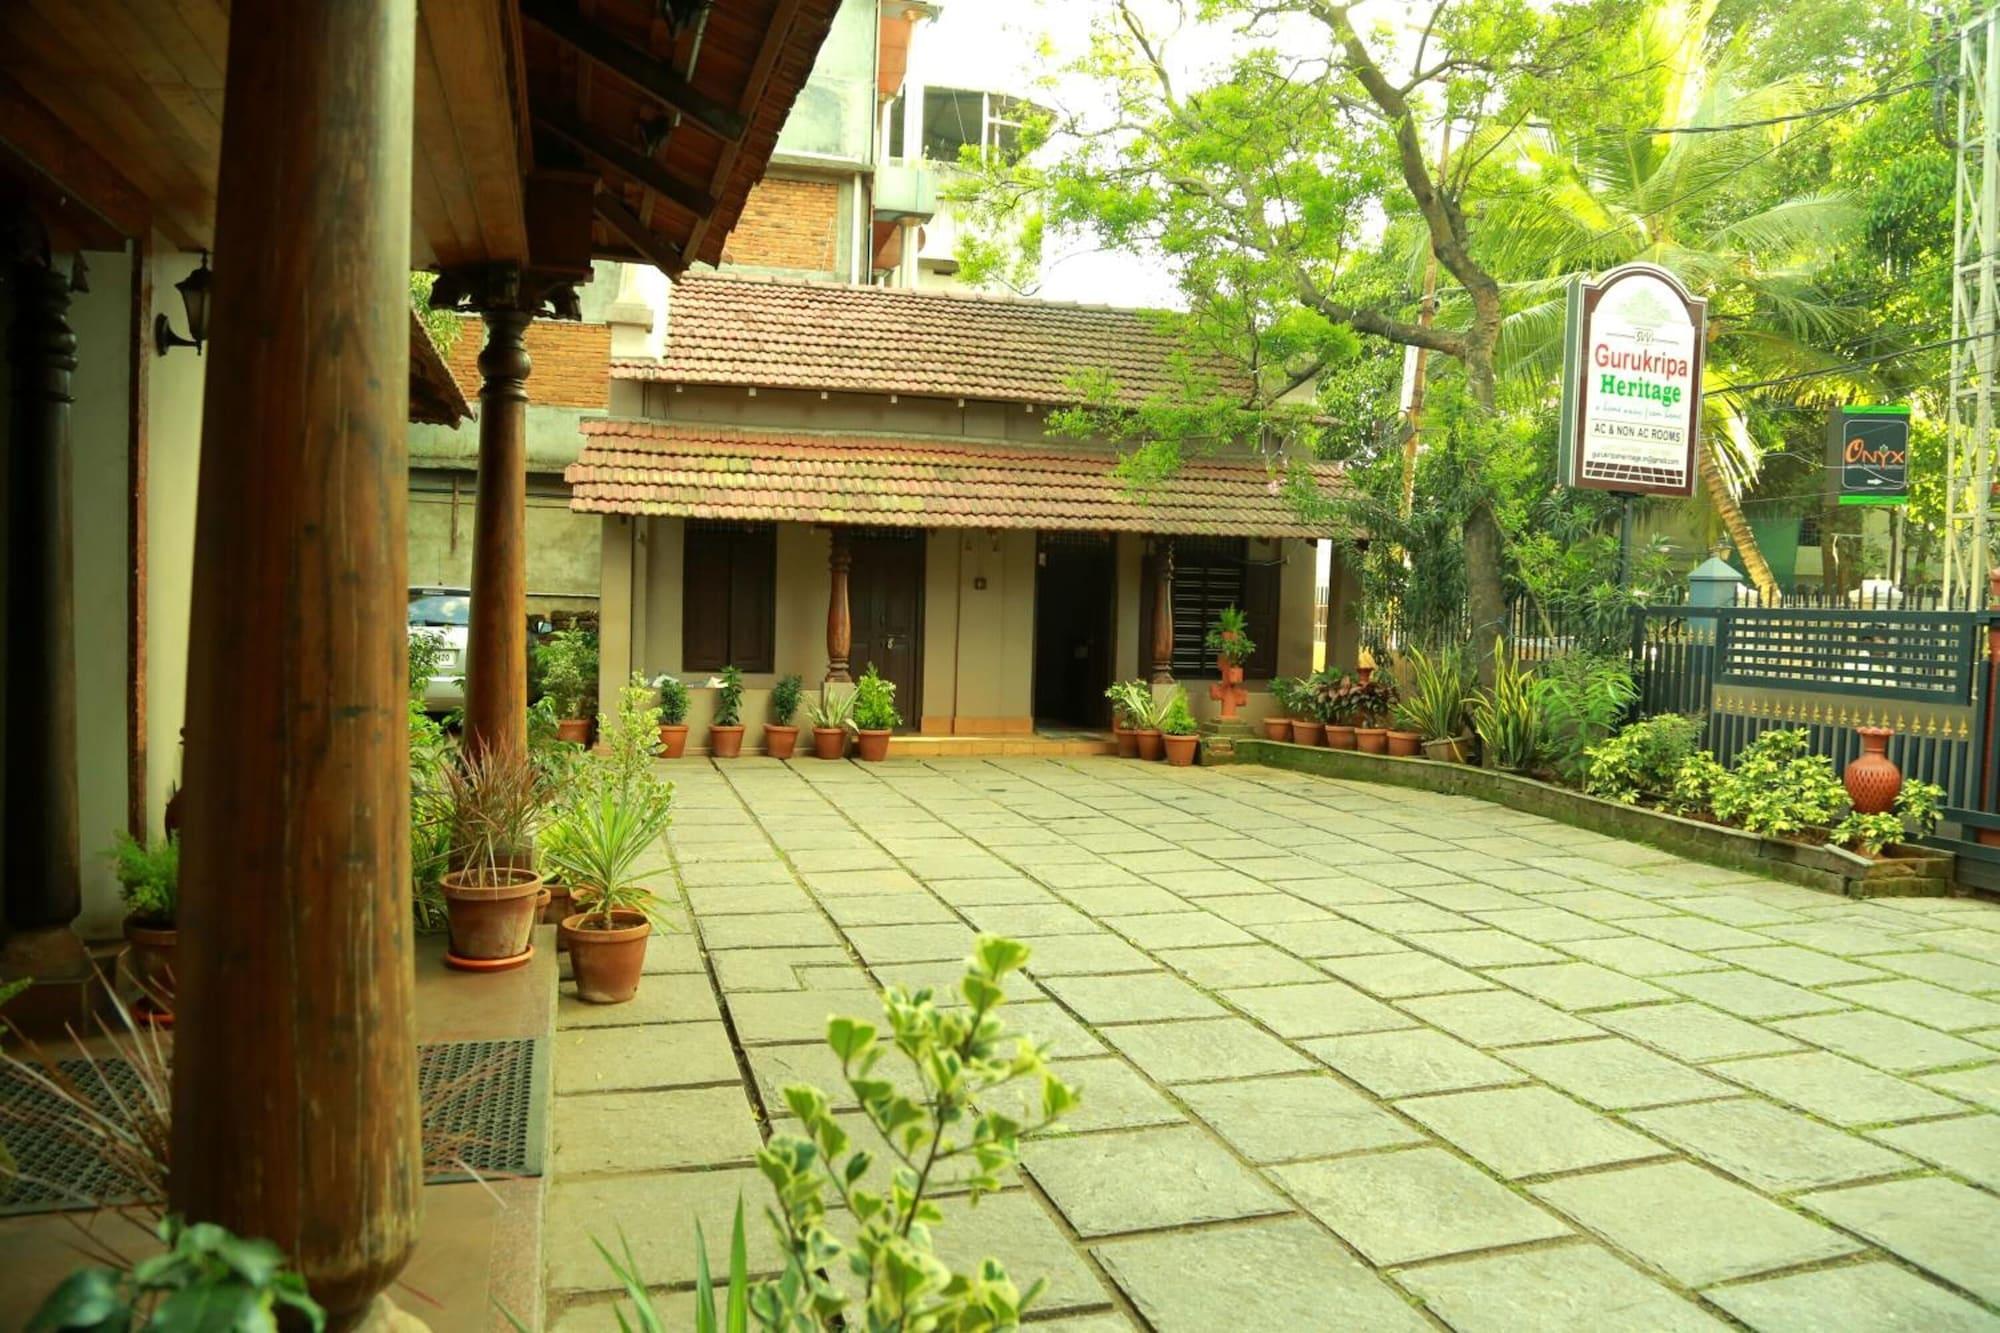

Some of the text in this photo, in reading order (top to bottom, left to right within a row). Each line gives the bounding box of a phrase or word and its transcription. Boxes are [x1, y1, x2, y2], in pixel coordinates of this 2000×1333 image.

[1595, 344, 1688, 380] Gurukripa
[1600, 374, 1681, 407] Heritage
[1594, 423, 1681, 442] AC & NON AC ROOMS
